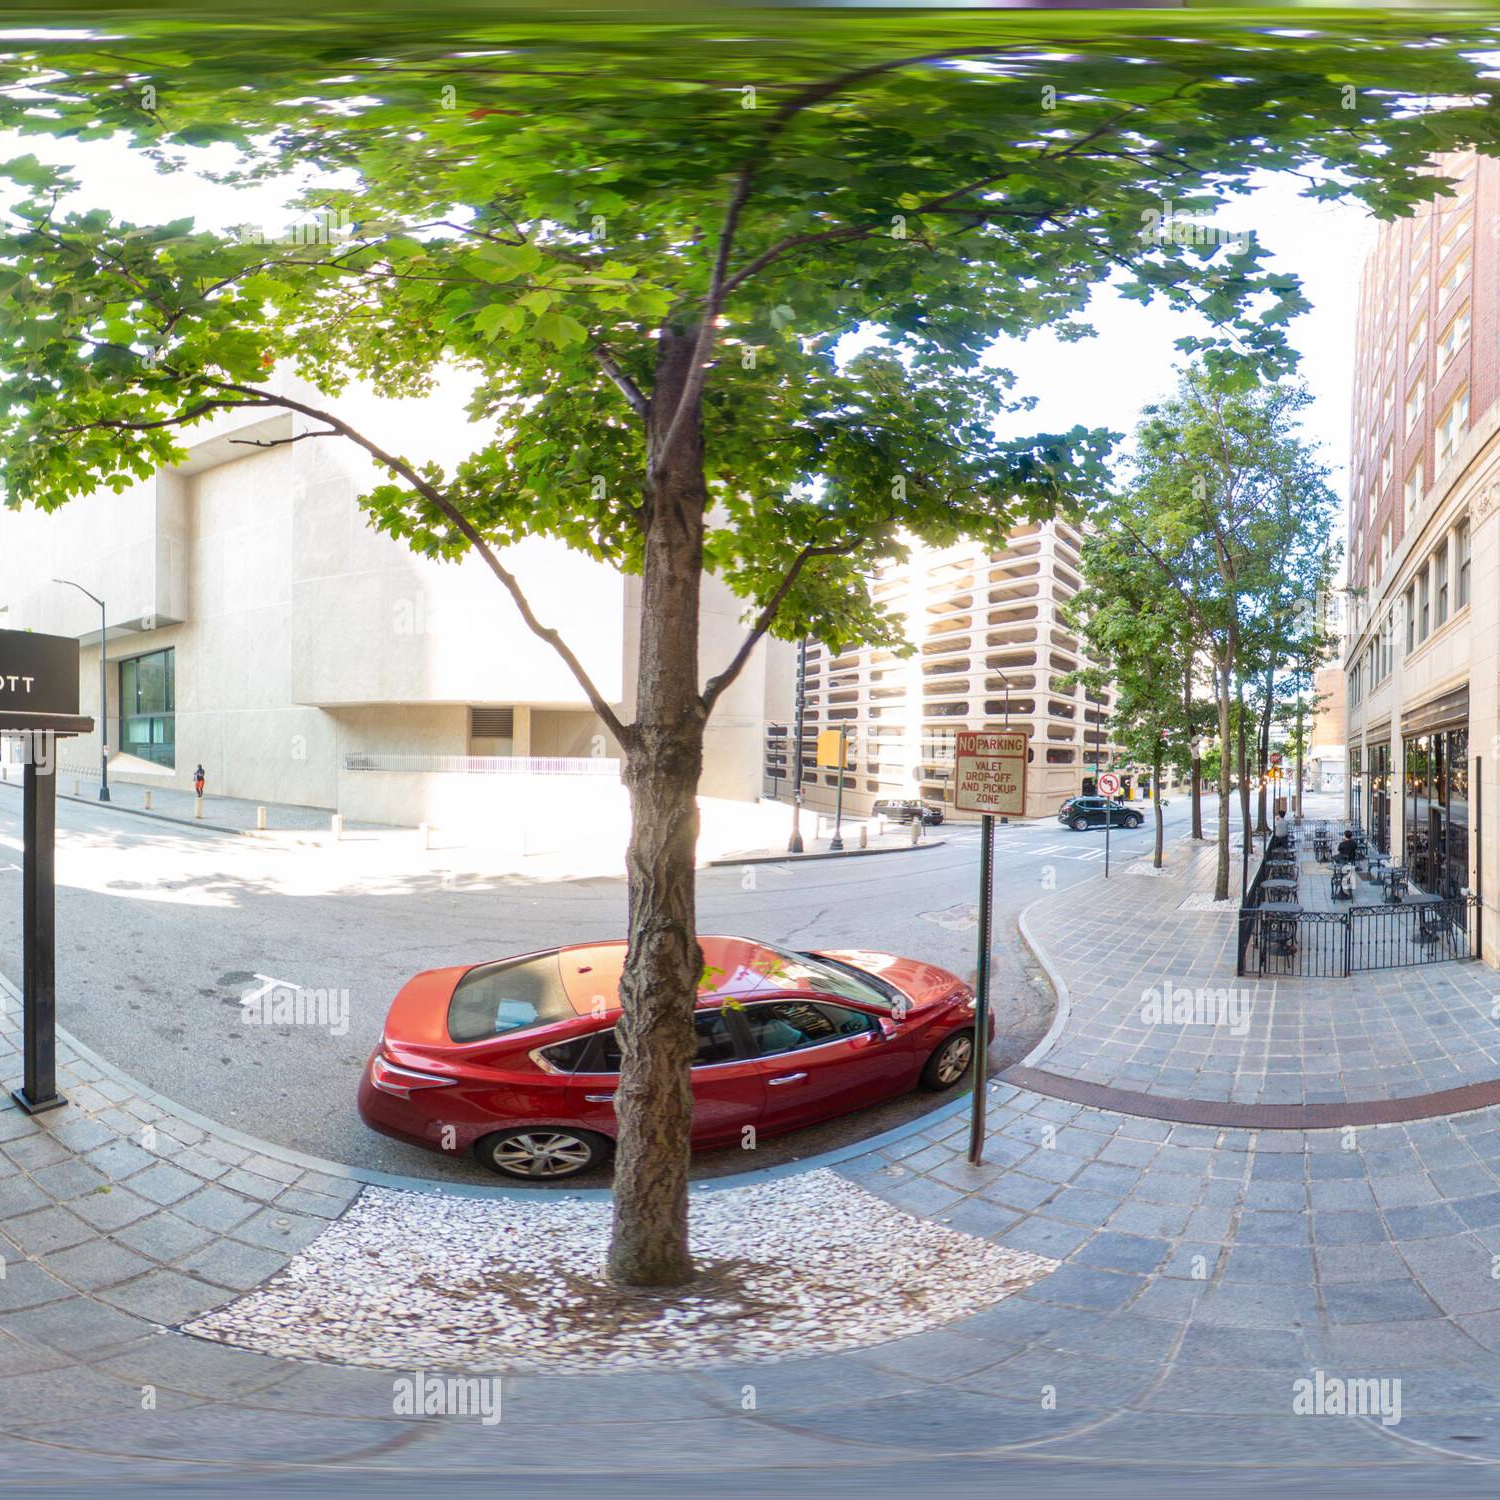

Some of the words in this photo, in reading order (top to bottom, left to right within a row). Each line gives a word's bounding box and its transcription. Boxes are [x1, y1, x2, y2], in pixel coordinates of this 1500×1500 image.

[959, 736, 976, 752] NO
[977, 739, 1022, 751] PARKING
[975, 761, 1002, 771] VALET
[966, 771, 1012, 783] DROP-OFF
[961, 782, 979, 792] AND
[983, 783, 1017, 794] PICKUP
[976, 794, 1000, 804] ZONE
